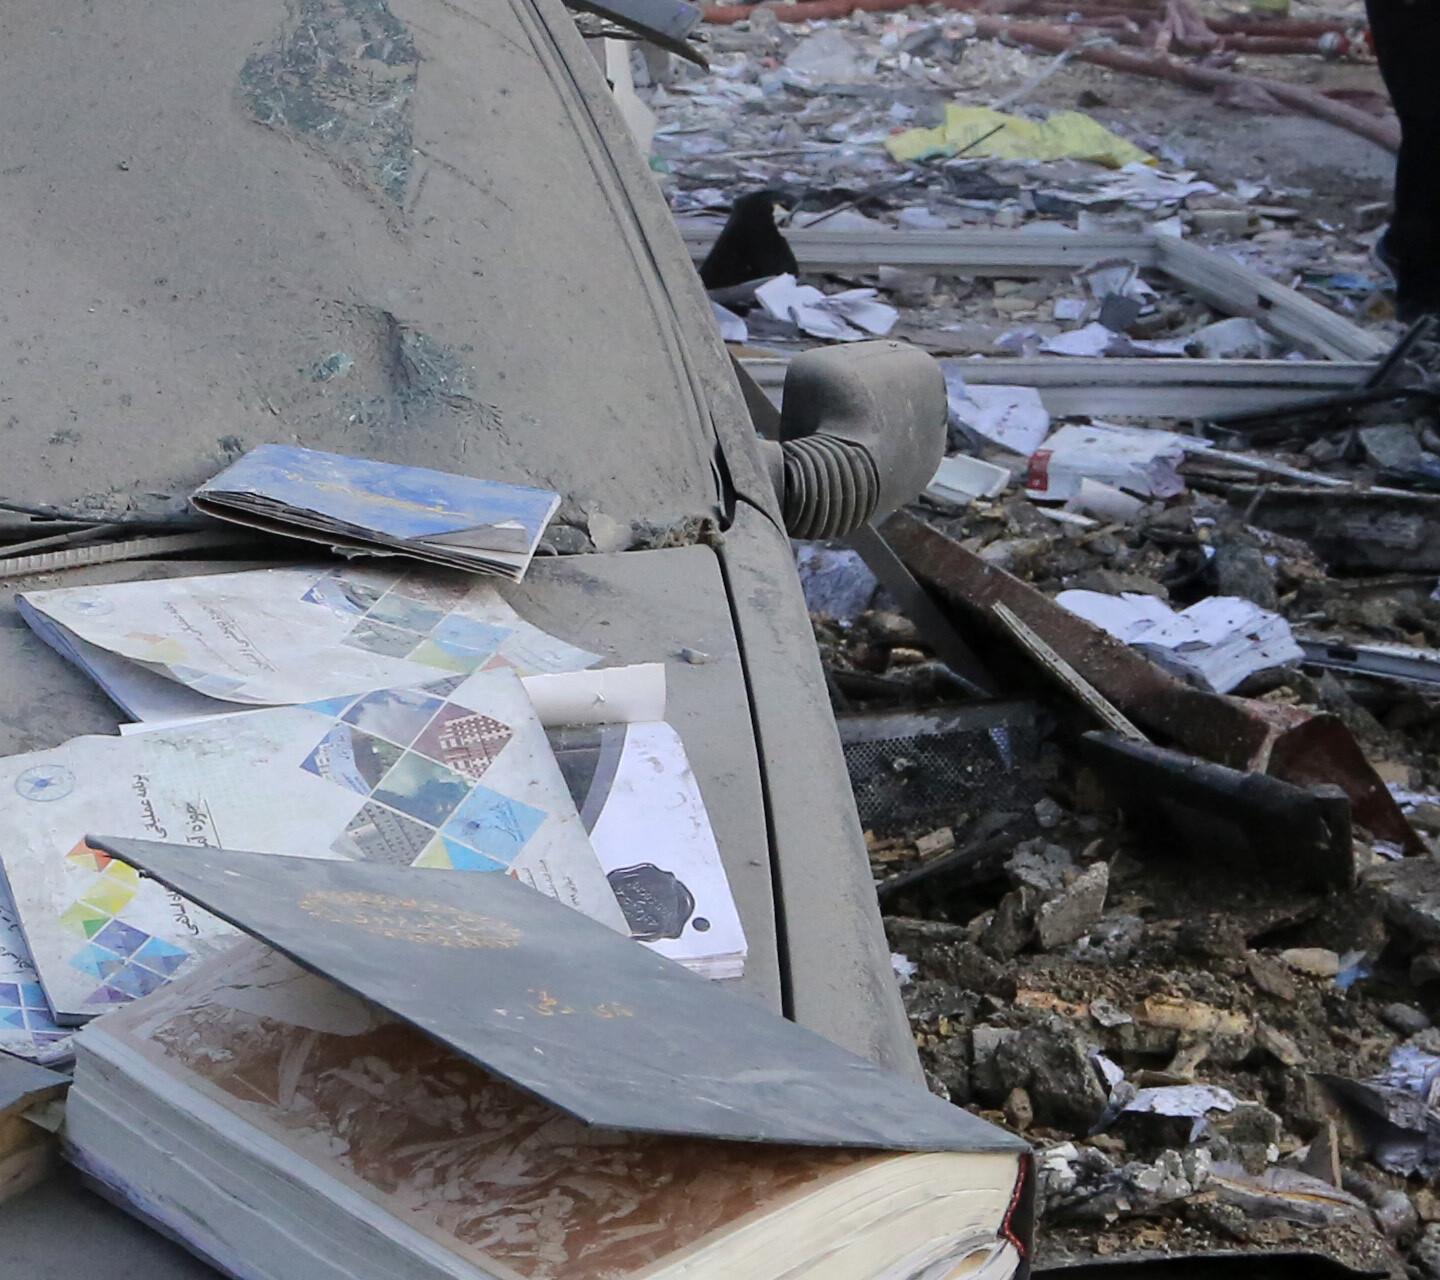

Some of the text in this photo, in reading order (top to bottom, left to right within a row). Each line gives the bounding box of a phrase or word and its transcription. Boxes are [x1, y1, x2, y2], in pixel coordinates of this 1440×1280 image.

[131, 773, 168, 839] برنامه عملیاتی
[185, 801, 208, 832] حوزه
